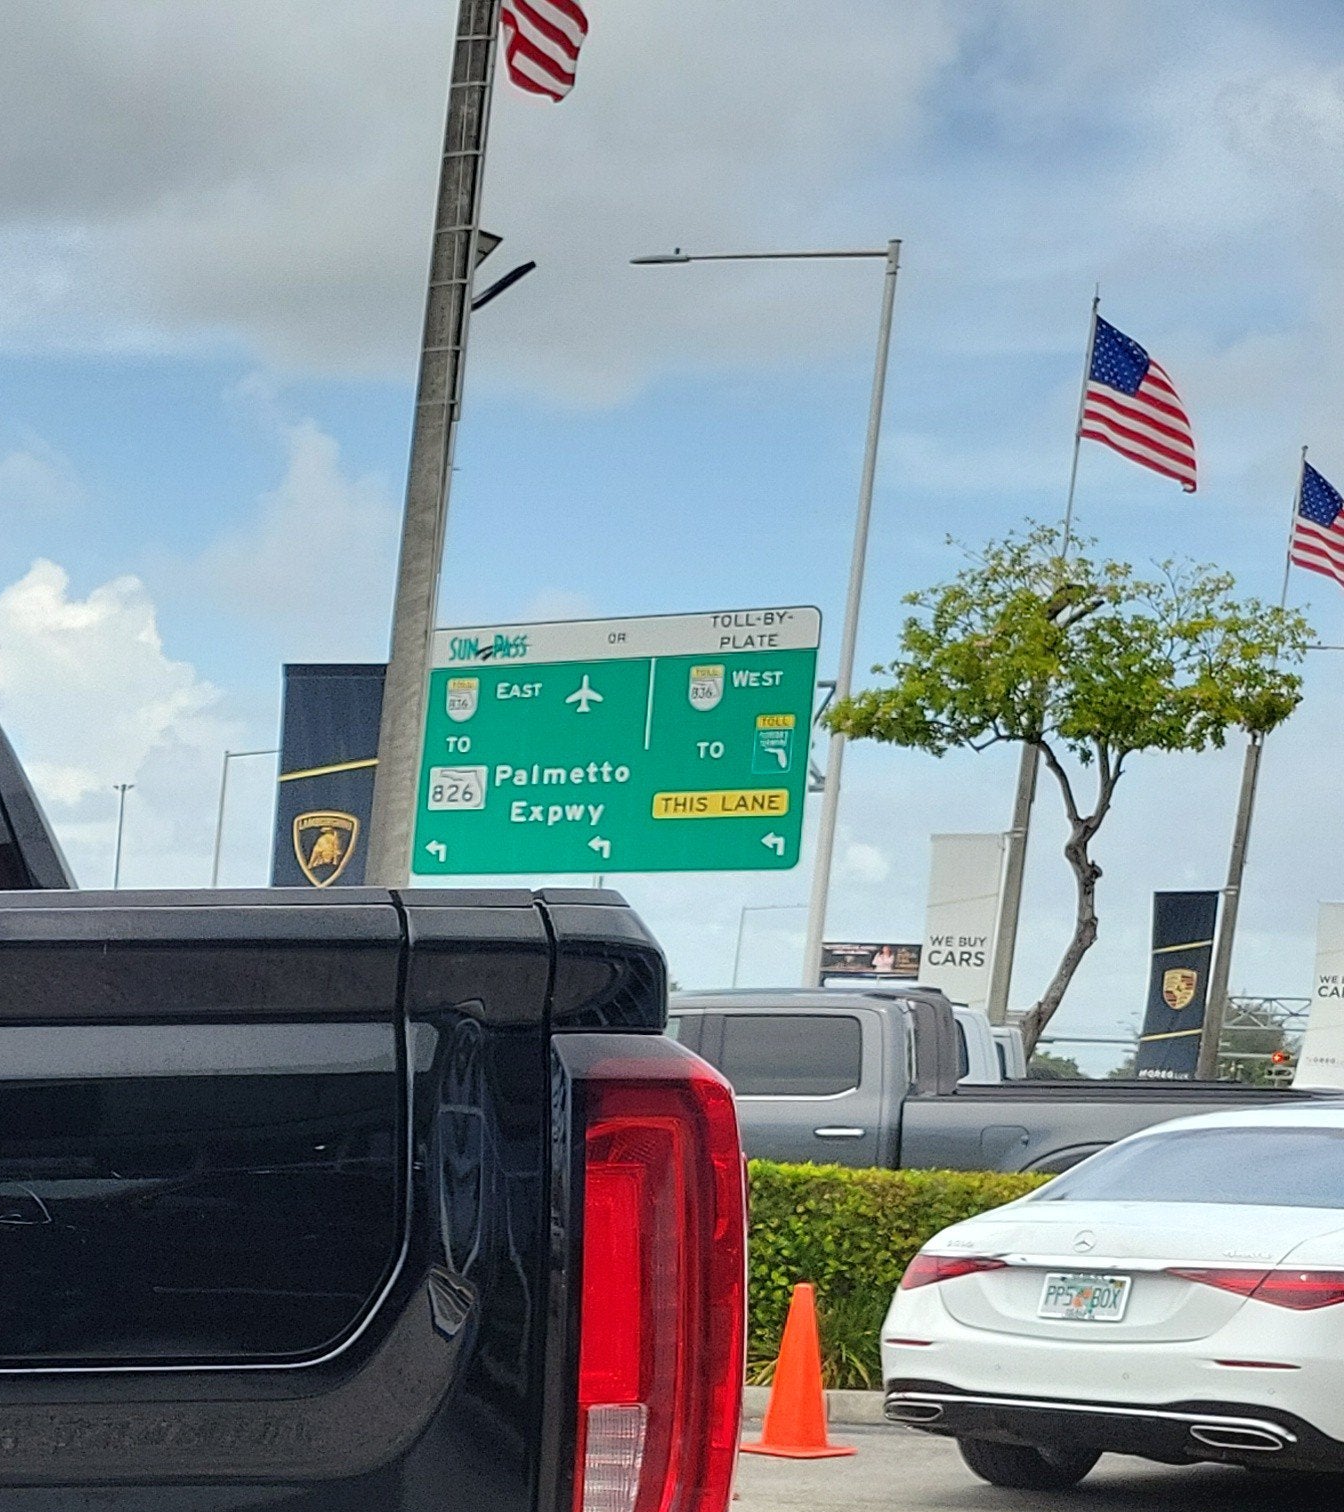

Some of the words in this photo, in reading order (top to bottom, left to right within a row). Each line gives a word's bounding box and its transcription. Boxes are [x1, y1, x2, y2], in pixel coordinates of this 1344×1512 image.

[712, 611, 794, 628] TOLL-BY-
[608, 633, 626, 644] OR
[720, 634, 779, 649] PLATE
[446, 736, 472, 753] TO
[696, 741, 725, 759] TO
[494, 761, 631, 787] Palmetto
[431, 784, 474, 802] 826
[662, 797, 708, 813] THIS
[721, 795, 781, 812] LANE
[510, 800, 605, 826] Expwy
[929, 935, 955, 947] WE
[958, 936, 987, 947] BUY
[928, 950, 986, 967] CARS
[1319, 975, 1339, 983] WE
[1318, 986, 1344, 998] CA
